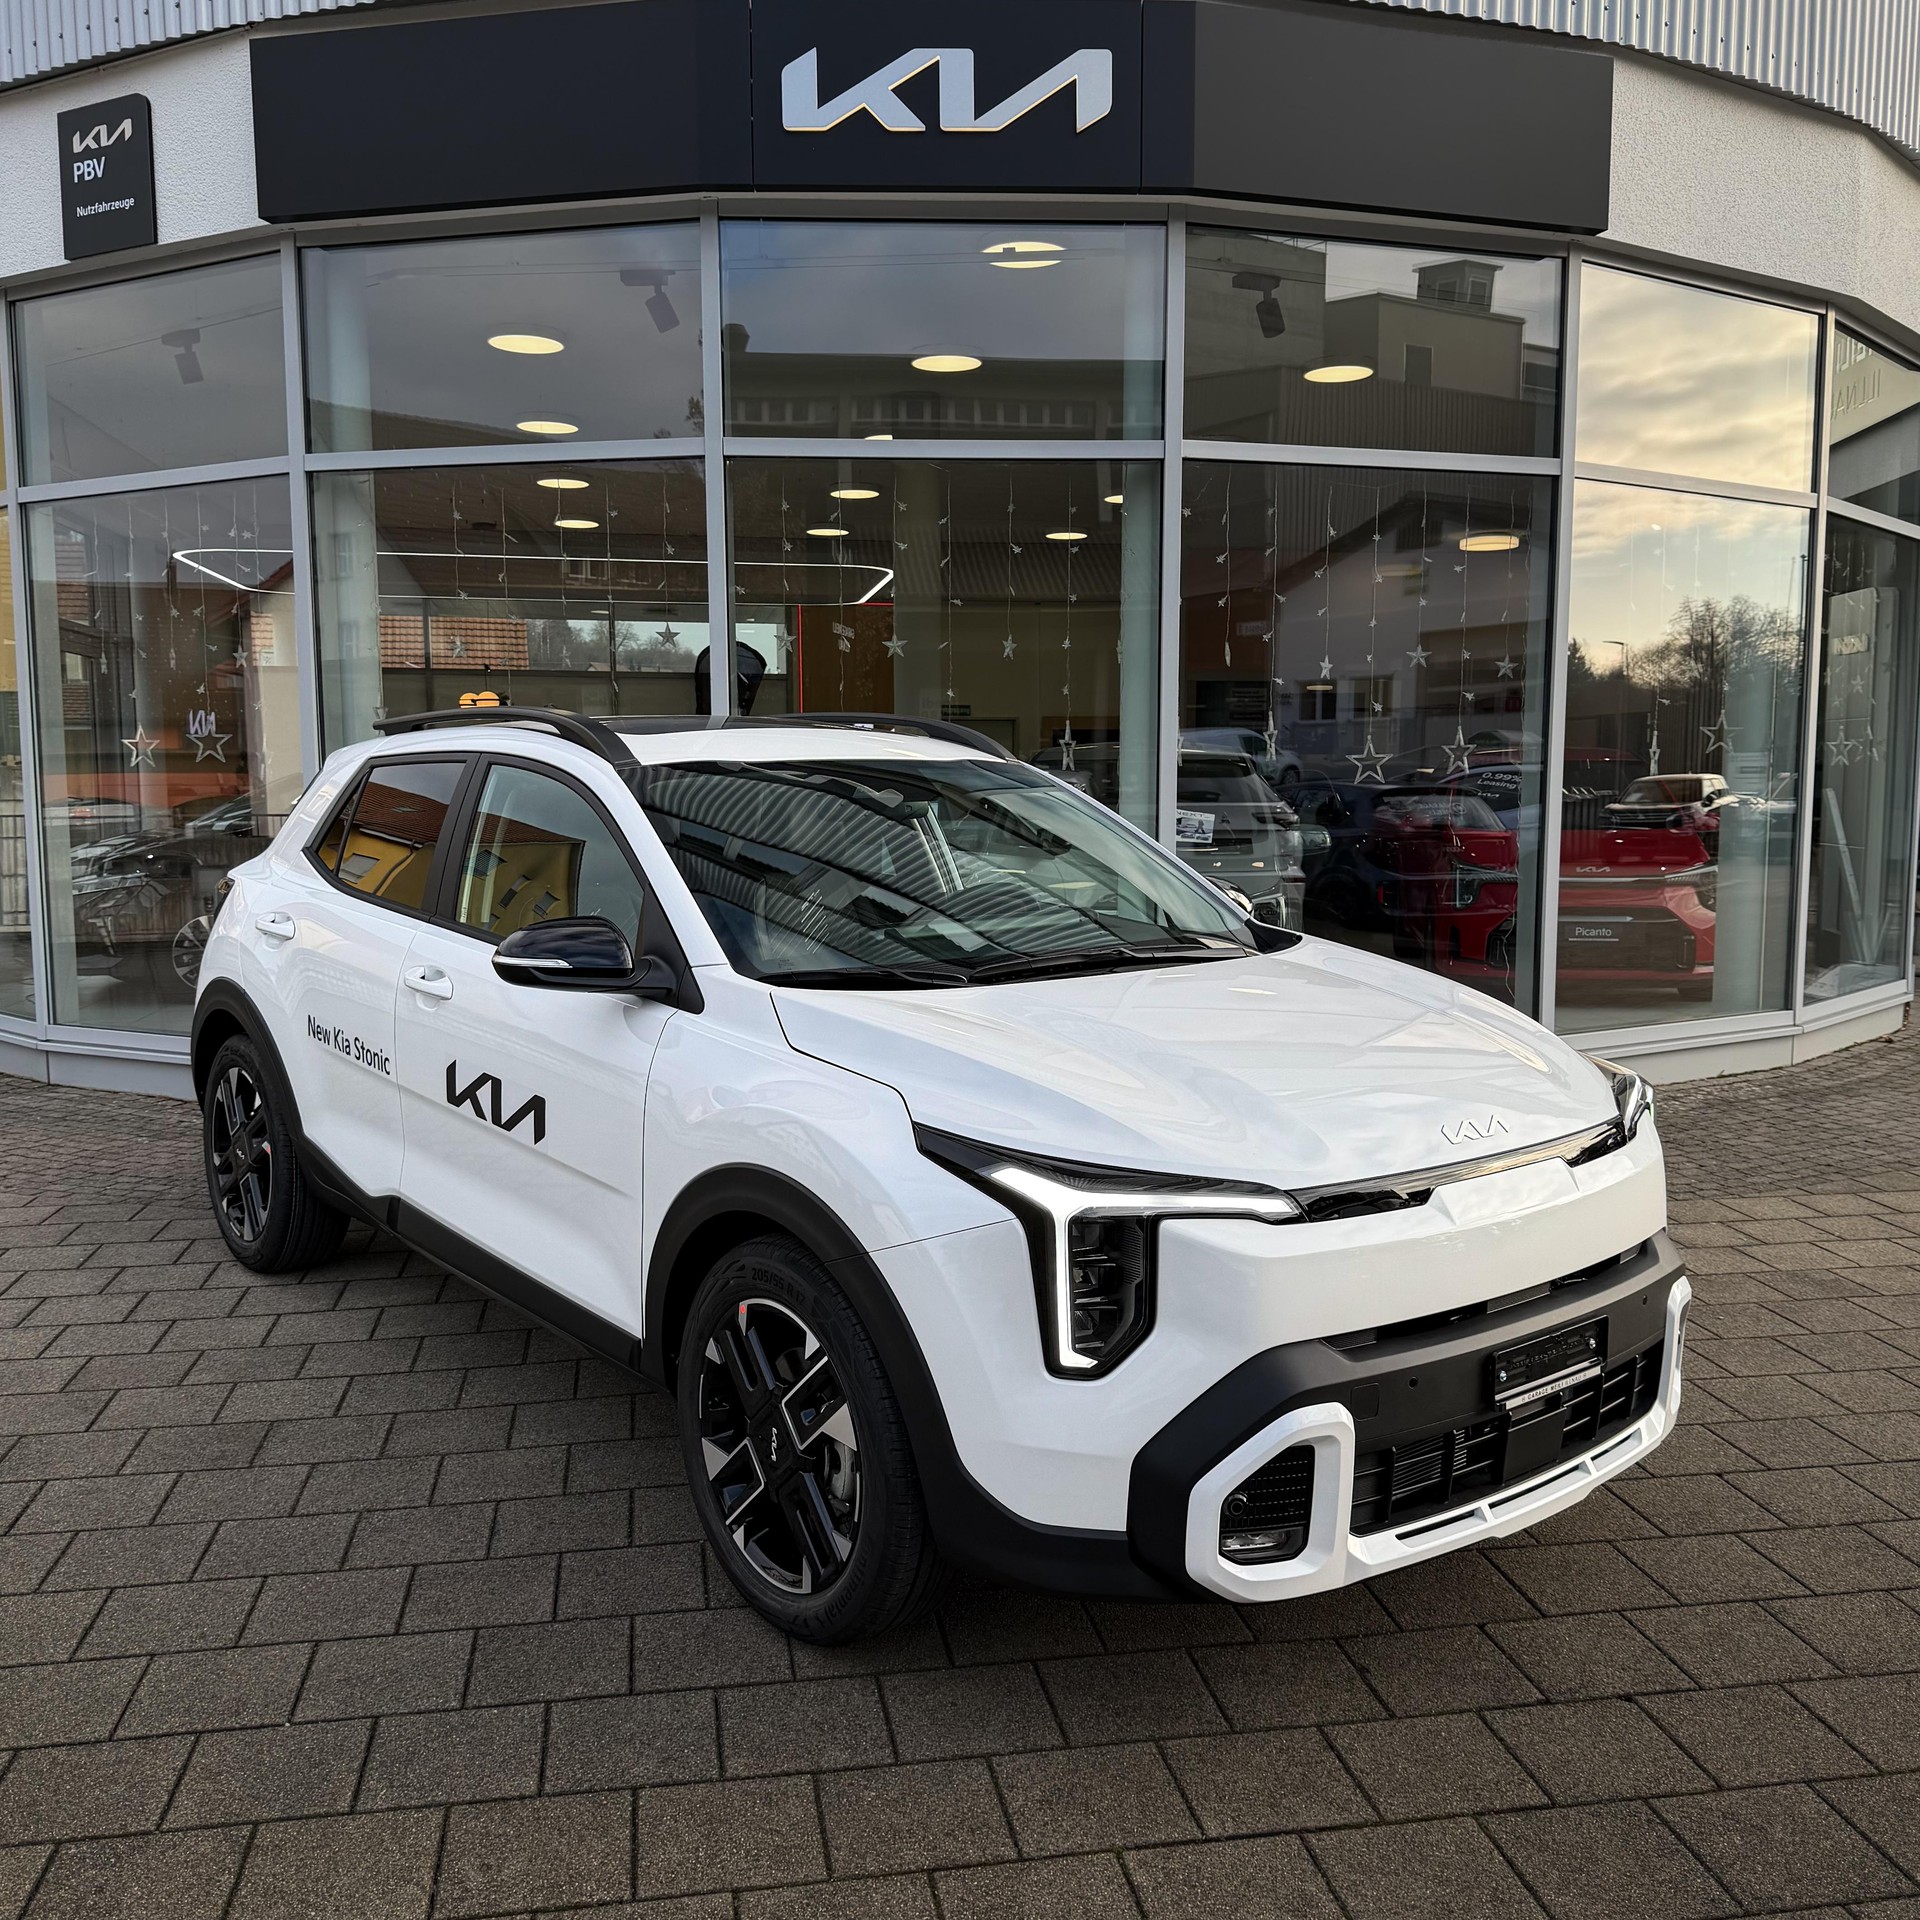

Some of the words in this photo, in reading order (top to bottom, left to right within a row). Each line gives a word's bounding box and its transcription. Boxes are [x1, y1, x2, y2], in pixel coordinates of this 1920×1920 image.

[781, 46, 1112, 133] KIA
[72, 118, 133, 153] KIA
[73, 157, 106, 183] PBV
[76, 196, 135, 217] Nutzfahrzeuge
[1477, 778, 1517, 789] Leasing
[1482, 772, 1523, 782] 0.99%
[1575, 926, 1612, 937] Picanto
[308, 1014, 331, 1046] New
[333, 1028, 351, 1055] Kia
[354, 1036, 391, 1075] Stonic
[446, 1059, 546, 1146] KIA
[751, 1267, 785, 1290] 205/55
